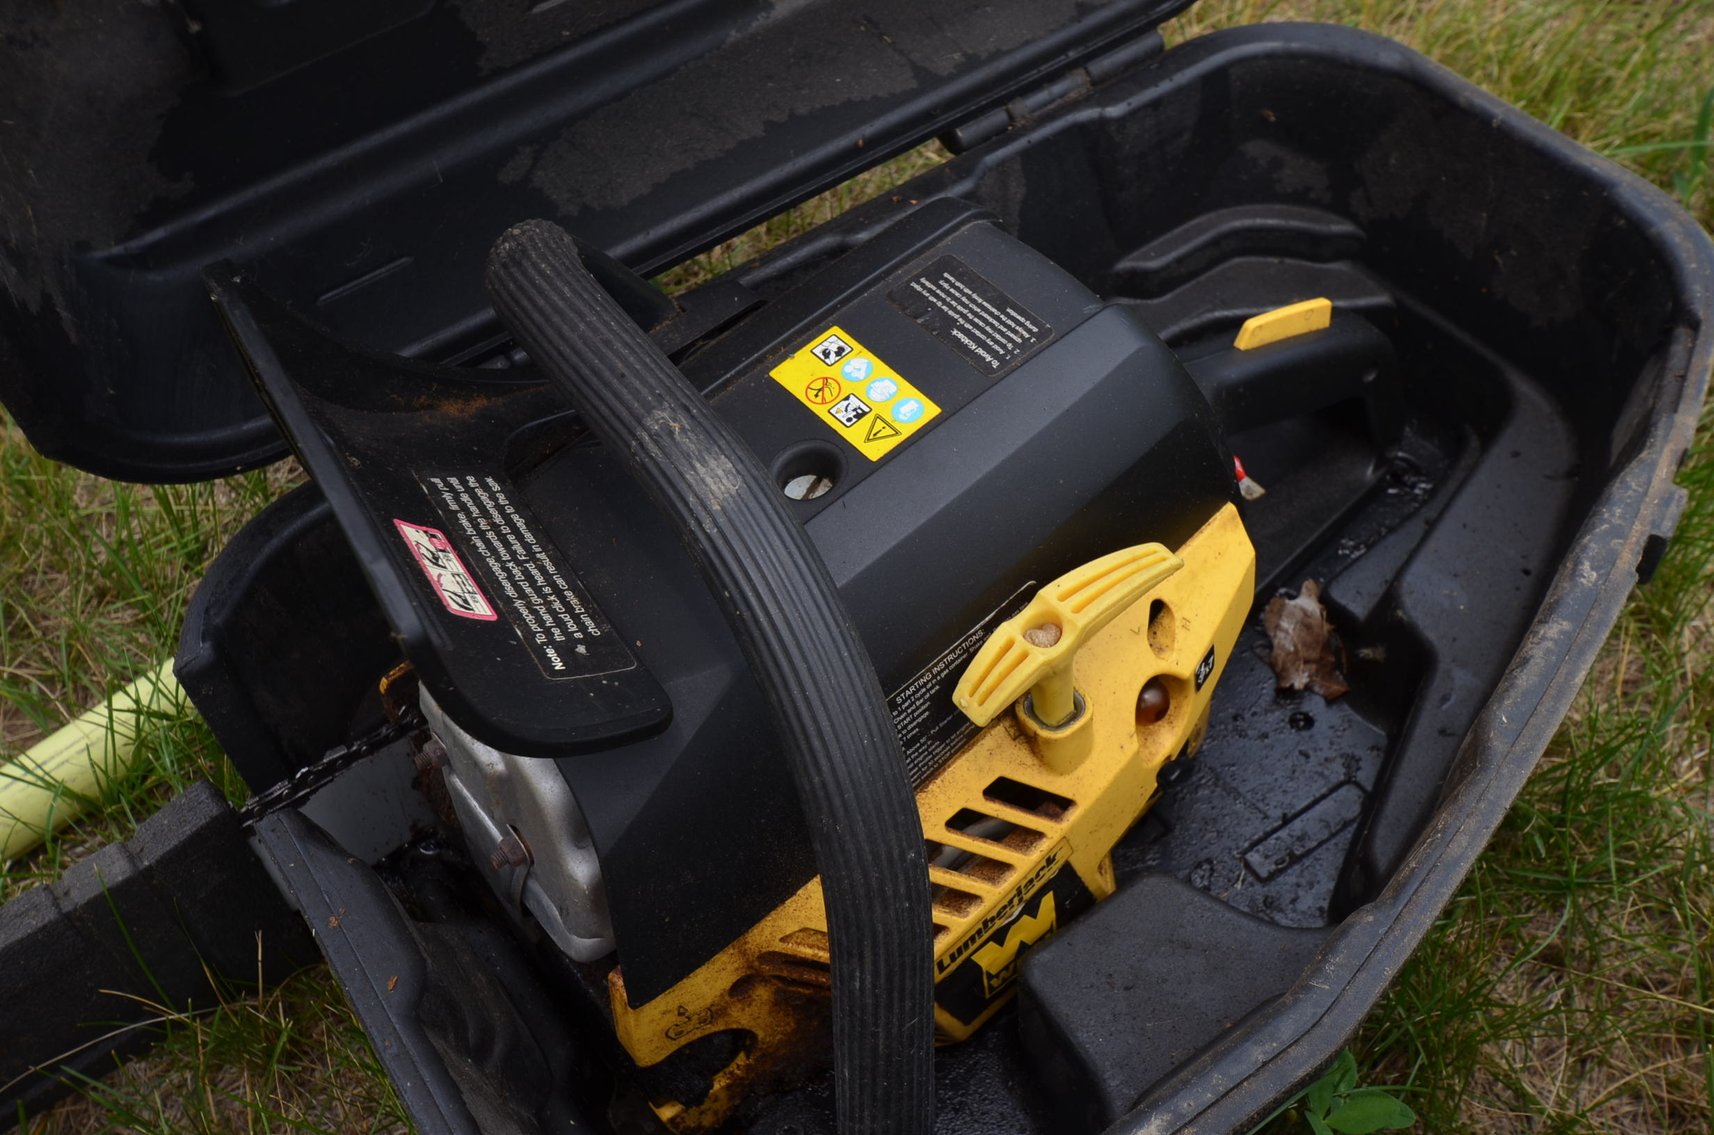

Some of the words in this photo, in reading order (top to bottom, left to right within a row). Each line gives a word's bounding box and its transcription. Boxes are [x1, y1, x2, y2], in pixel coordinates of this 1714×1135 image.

[979, 311, 1000, 327] backward
[971, 328, 987, 340] contact
[974, 347, 993, 361] Avoid
[991, 344, 1005, 354] Avoid
[991, 359, 1000, 368] To
[430, 477, 449, 490] pull
[446, 477, 464, 492] until
[466, 475, 480, 488] the
[484, 476, 501, 491] saw.
[441, 491, 460, 510] firmly
[460, 492, 481, 517] handle
[475, 488, 504, 524] disengage
[495, 492, 509, 505] the
[504, 505, 515, 513] to
[457, 512, 476, 535] brake,
[477, 517, 490, 530] the
[500, 525, 511, 533] to
[510, 513, 536, 543] damage
[471, 536, 490, 556] chain
[486, 531, 511, 560] towards
[506, 534, 529, 560] Failure
[531, 544, 542, 552] in
[505, 561, 524, 580] back
[535, 552, 557, 573] result
[523, 561, 546, 585] heard.
[552, 574, 568, 589] can
[517, 581, 542, 604] guard
[542, 586, 552, 594] is
[547, 594, 565, 612] click
[564, 590, 584, 613] brake
[513, 599, 543, 631] properly
[533, 605, 555, 626] hand
[558, 613, 578, 631] loud
[551, 627, 565, 641] the
[580, 614, 600, 636] chain
[535, 633, 547, 644] To
[543, 645, 565, 670] Note:
[896, 672, 932, 703] STARTING
[936, 851, 1057, 974] Lumberjack
